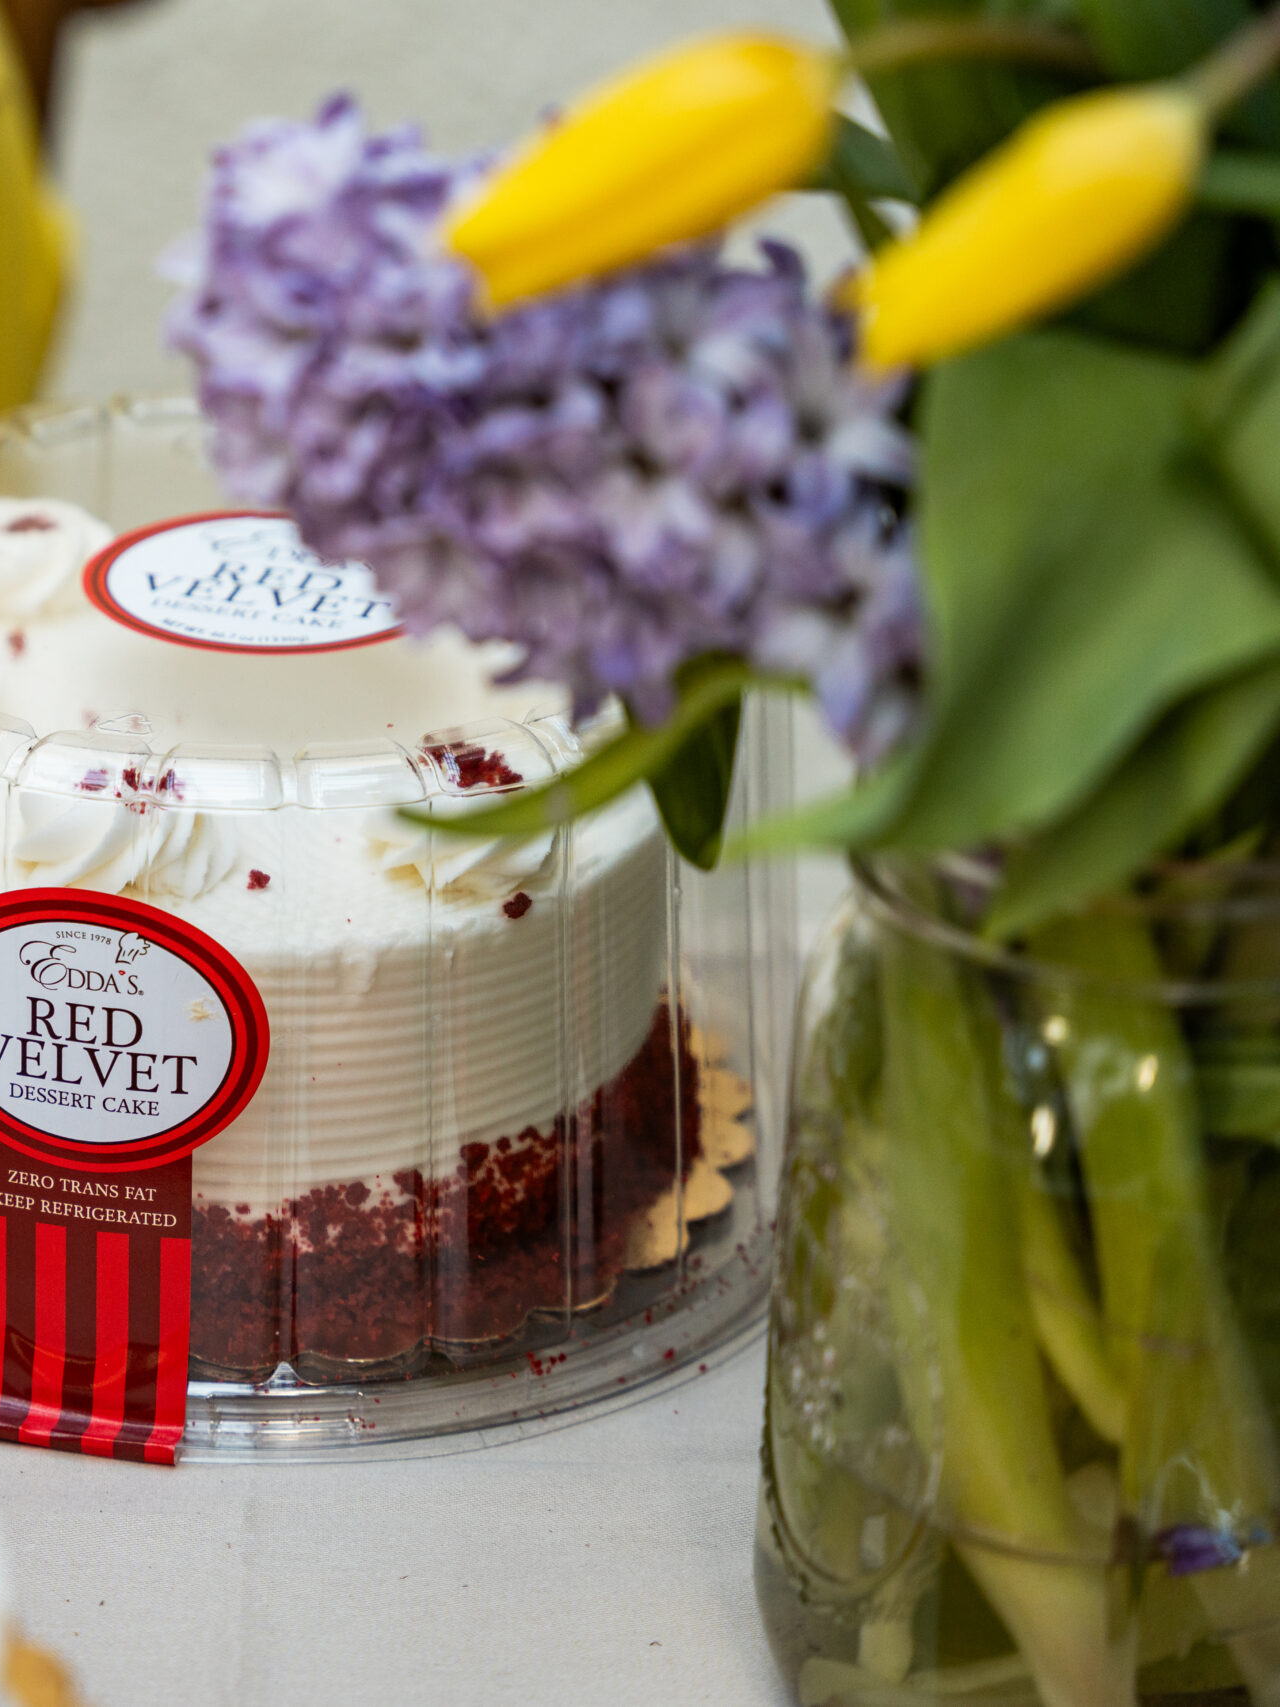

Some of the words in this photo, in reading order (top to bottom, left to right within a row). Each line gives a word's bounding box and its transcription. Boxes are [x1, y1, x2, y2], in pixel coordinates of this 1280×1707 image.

[213, 561, 342, 591] RED
[147, 572, 392, 619] VELVET
[271, 612, 343, 630] CAKE
[55, 930, 87, 940] SINCE
[90, 933, 111, 945] 1978
[26, 996, 143, 1048] RED
[9, 1082, 95, 1110] DESSERT
[102, 1096, 160, 1116] CAKE
[8, 1169, 54, 1189] ZERO
[59, 1178, 119, 1199] TRANS
[125, 1187, 157, 1202] FAT
[41, 1198, 177, 1228] REFRIGERATED
